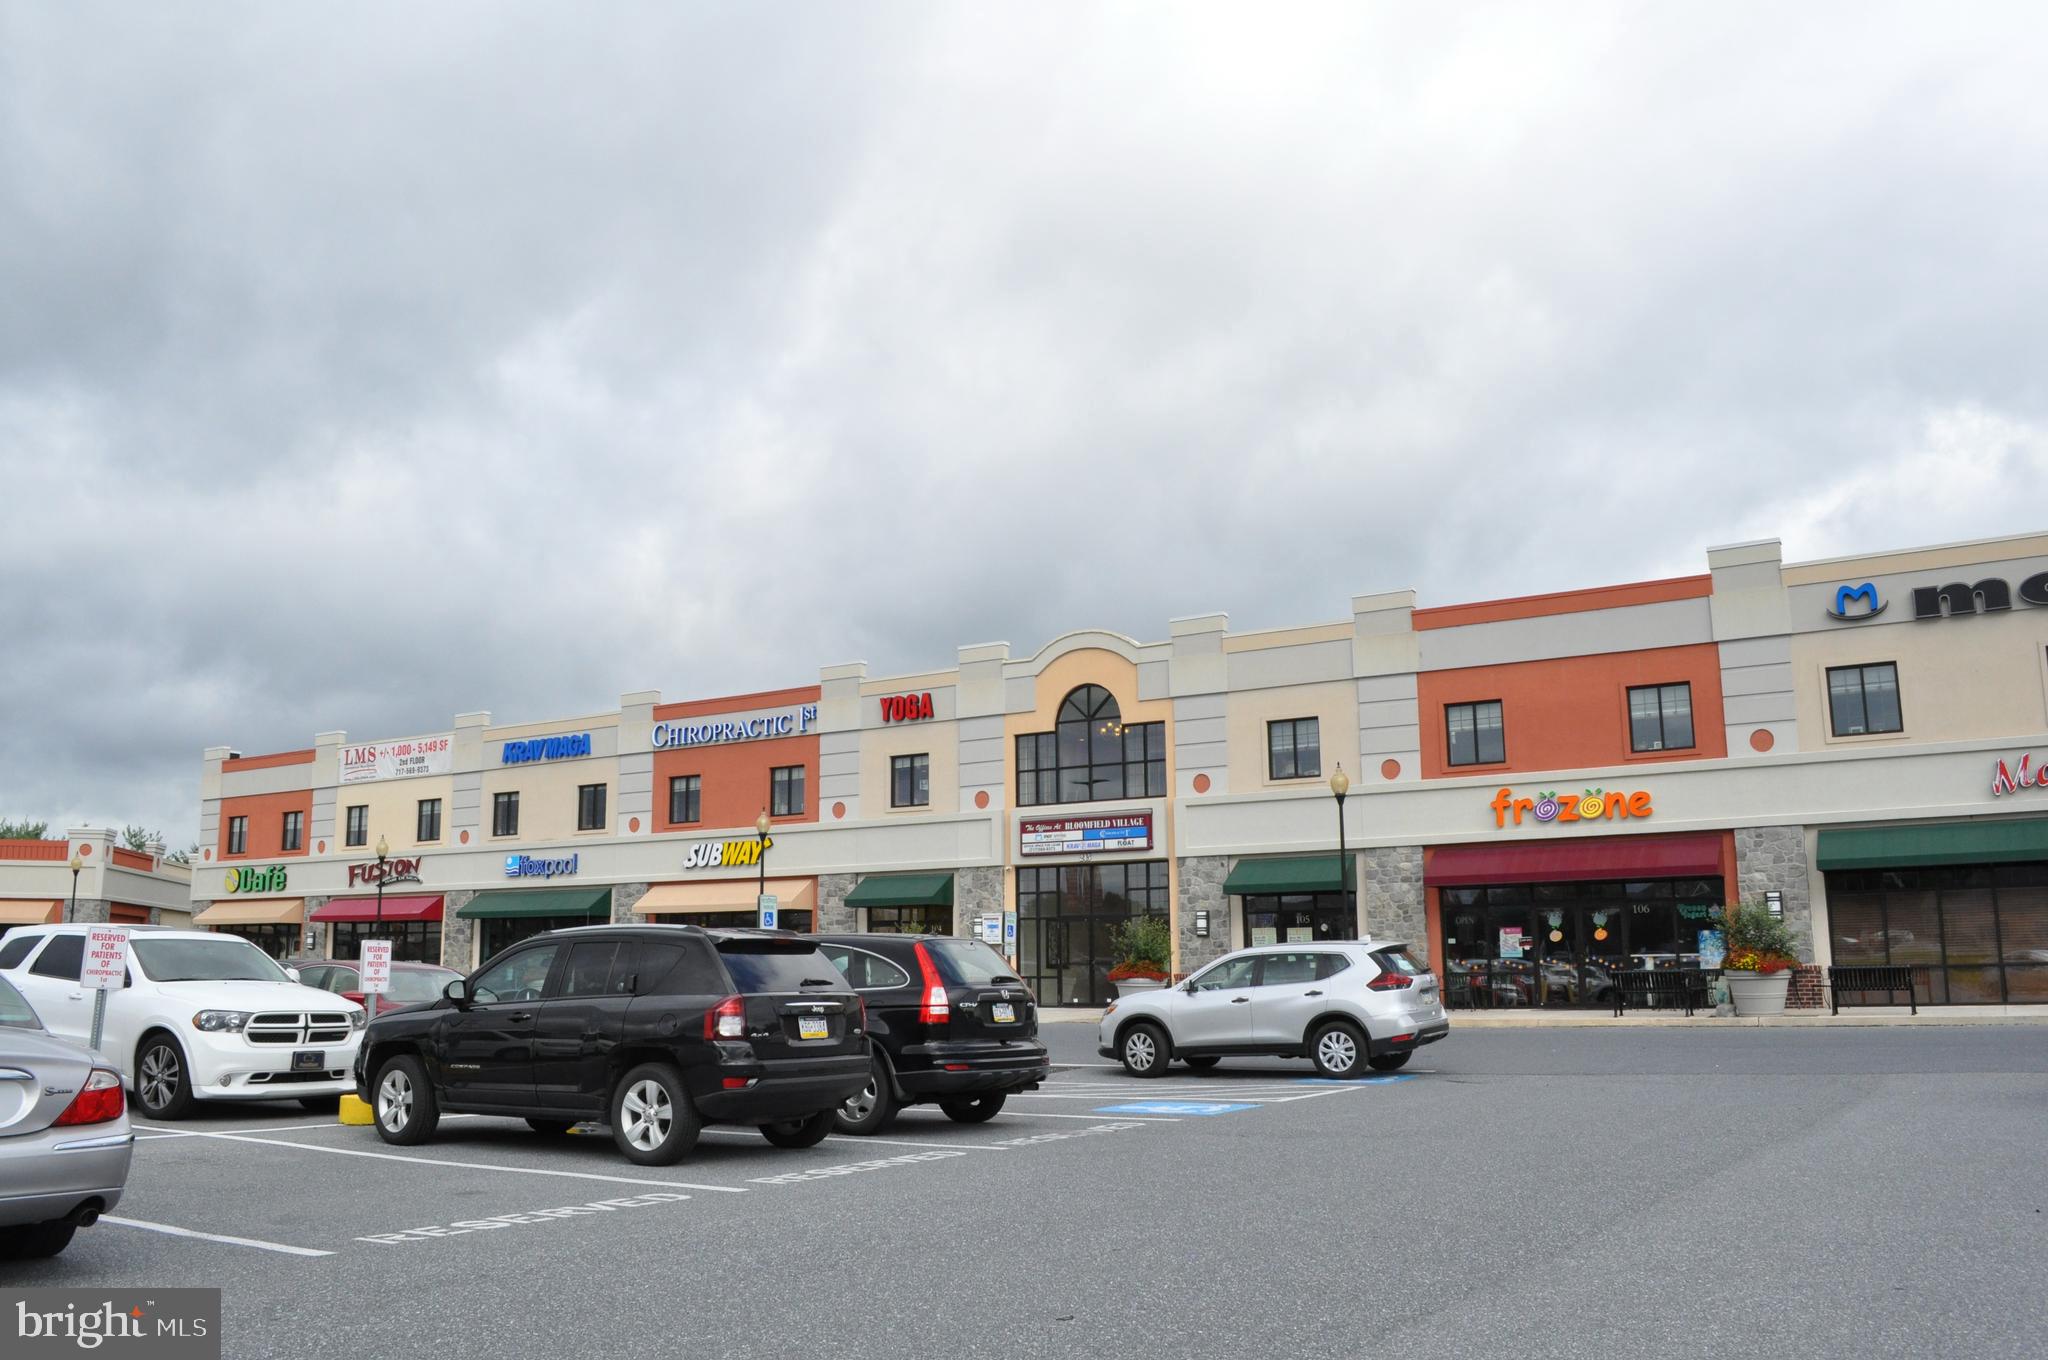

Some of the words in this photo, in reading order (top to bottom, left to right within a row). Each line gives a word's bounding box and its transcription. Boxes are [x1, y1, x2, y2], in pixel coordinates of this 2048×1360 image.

[880, 693, 934, 722] YOGA
[652, 713, 793, 748] CHIROPRACTIC
[799, 704, 817, 732] 1st
[344, 747, 376, 766] LMS
[392, 744, 412, 758] 1,000
[418, 741, 438, 754] 5,149
[439, 740, 449, 751] SF
[502, 738, 546, 765] KRAV
[545, 734, 591, 761] MAGA
[400, 758, 408, 766] 2nd
[409, 756, 425, 764] FLOOR
[1065, 819, 1110, 830] BLOOMFIELD
[1112, 817, 1144, 827] VILLAGE
[683, 838, 773, 869] SUBWAY
[348, 856, 421, 888] FUSION
[519, 853, 578, 880] foxpool
[240, 864, 287, 893] Café
[1296, 913, 1310, 924] 105
[1632, 904, 1650, 914] 106
[92, 933, 126, 942] RESERVED
[101, 942, 115, 950] FOR
[91, 951, 122, 959] PATIENTS
[745, 1151, 968, 1185] RESERVED
[352, 1192, 692, 1245] RESERVED
